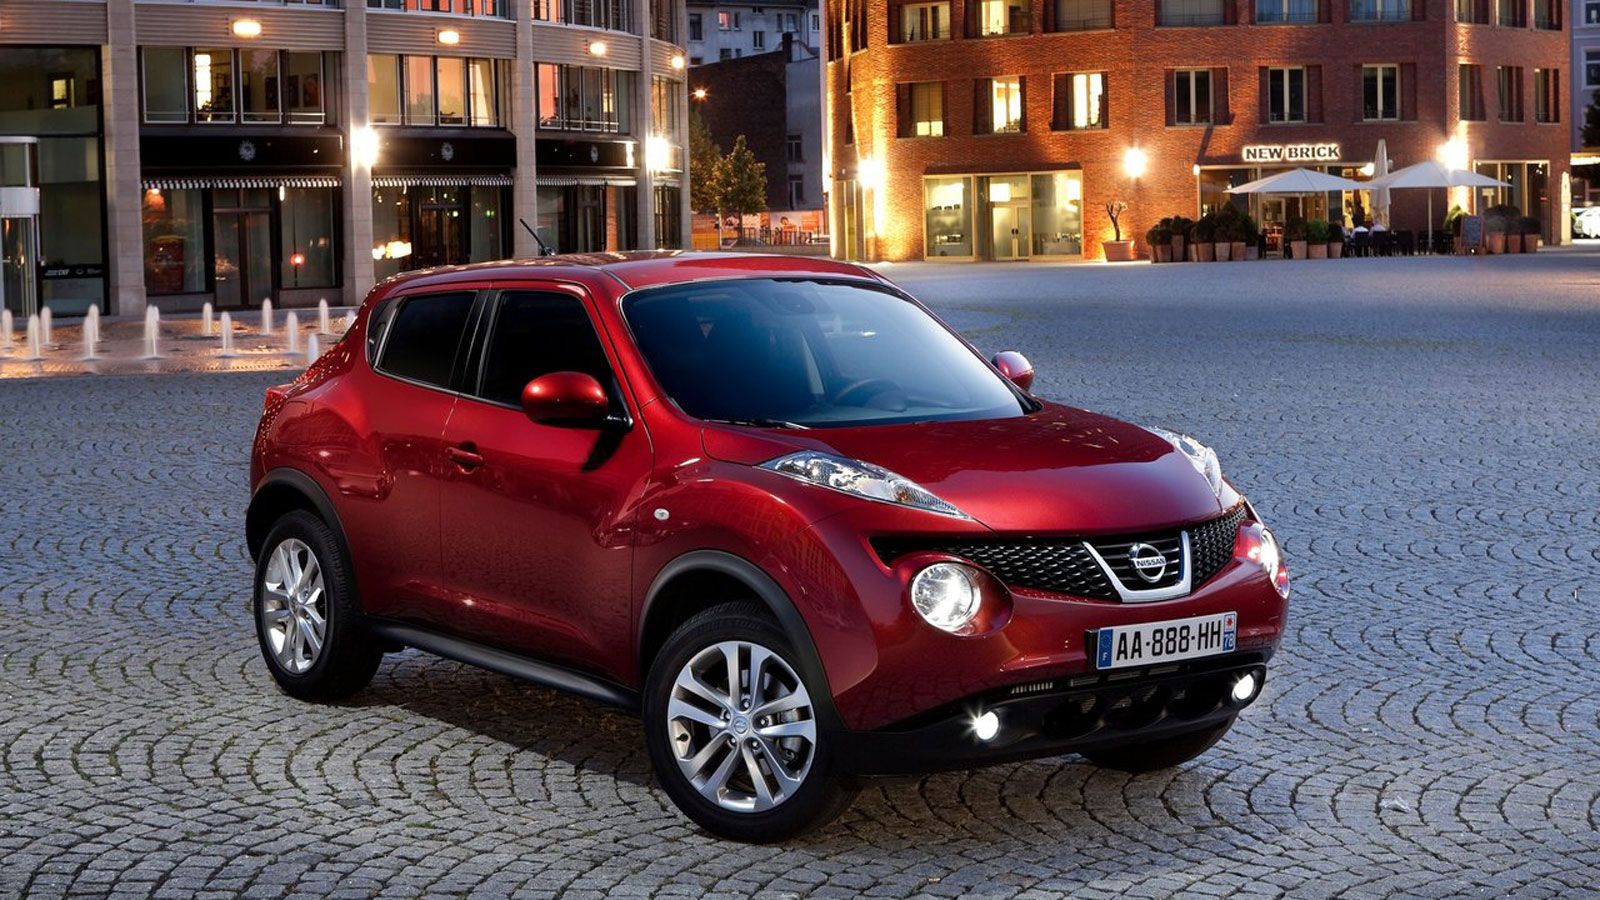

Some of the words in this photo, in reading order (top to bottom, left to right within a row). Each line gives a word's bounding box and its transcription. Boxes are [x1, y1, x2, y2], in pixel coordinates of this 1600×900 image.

[1245, 147, 1283, 160] NEW
[1287, 145, 1340, 159] BRICK
[1136, 558, 1165, 567] NISSAN
[1102, 652, 1109, 661] F
